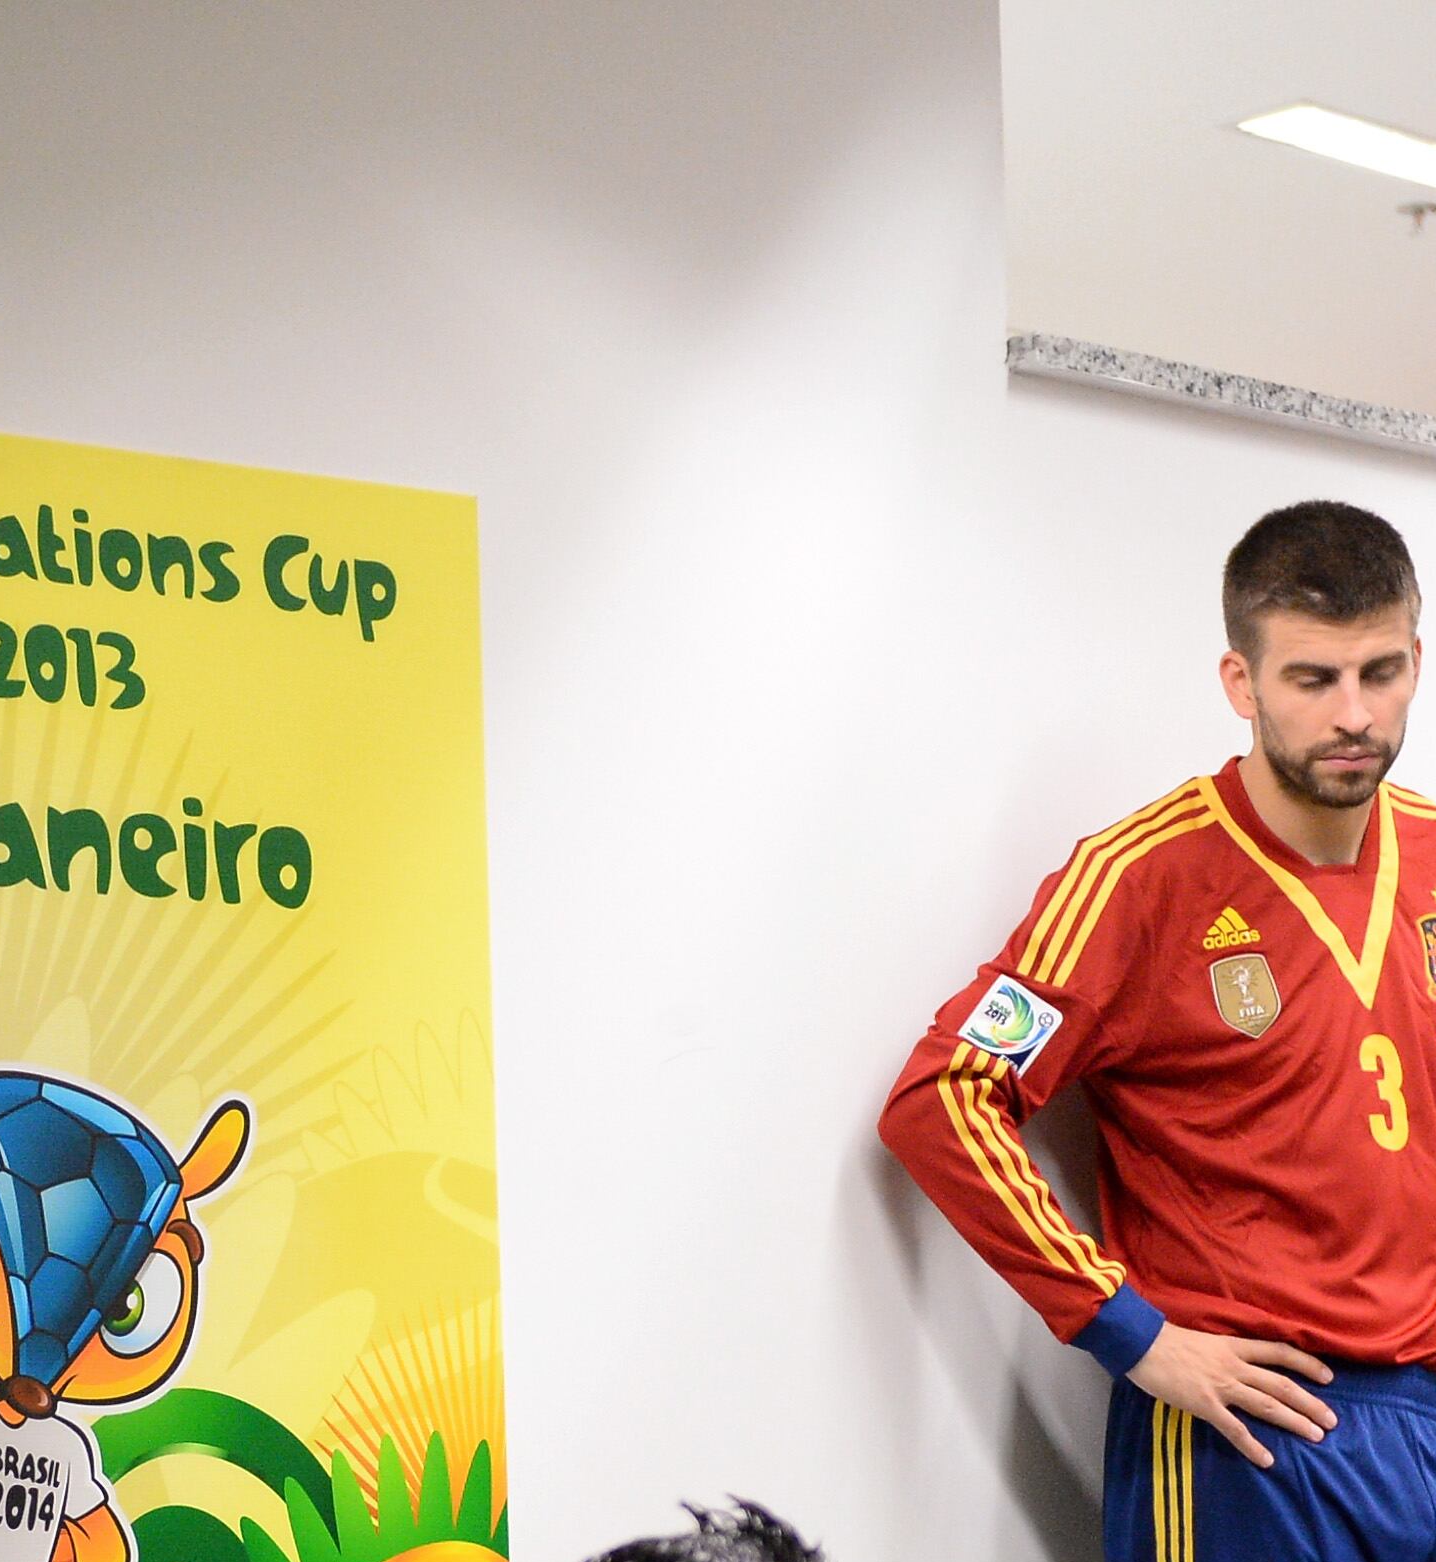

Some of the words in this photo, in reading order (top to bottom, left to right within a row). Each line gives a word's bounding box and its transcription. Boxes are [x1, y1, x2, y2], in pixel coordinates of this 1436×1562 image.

[262, 534, 397, 643] Cup
[1202, 928, 1261, 950] adidas
[984, 1004, 1008, 1026] 2013
[1239, 1004, 1266, 1018] FIFA
[1360, 1033, 1410, 1153] 3
